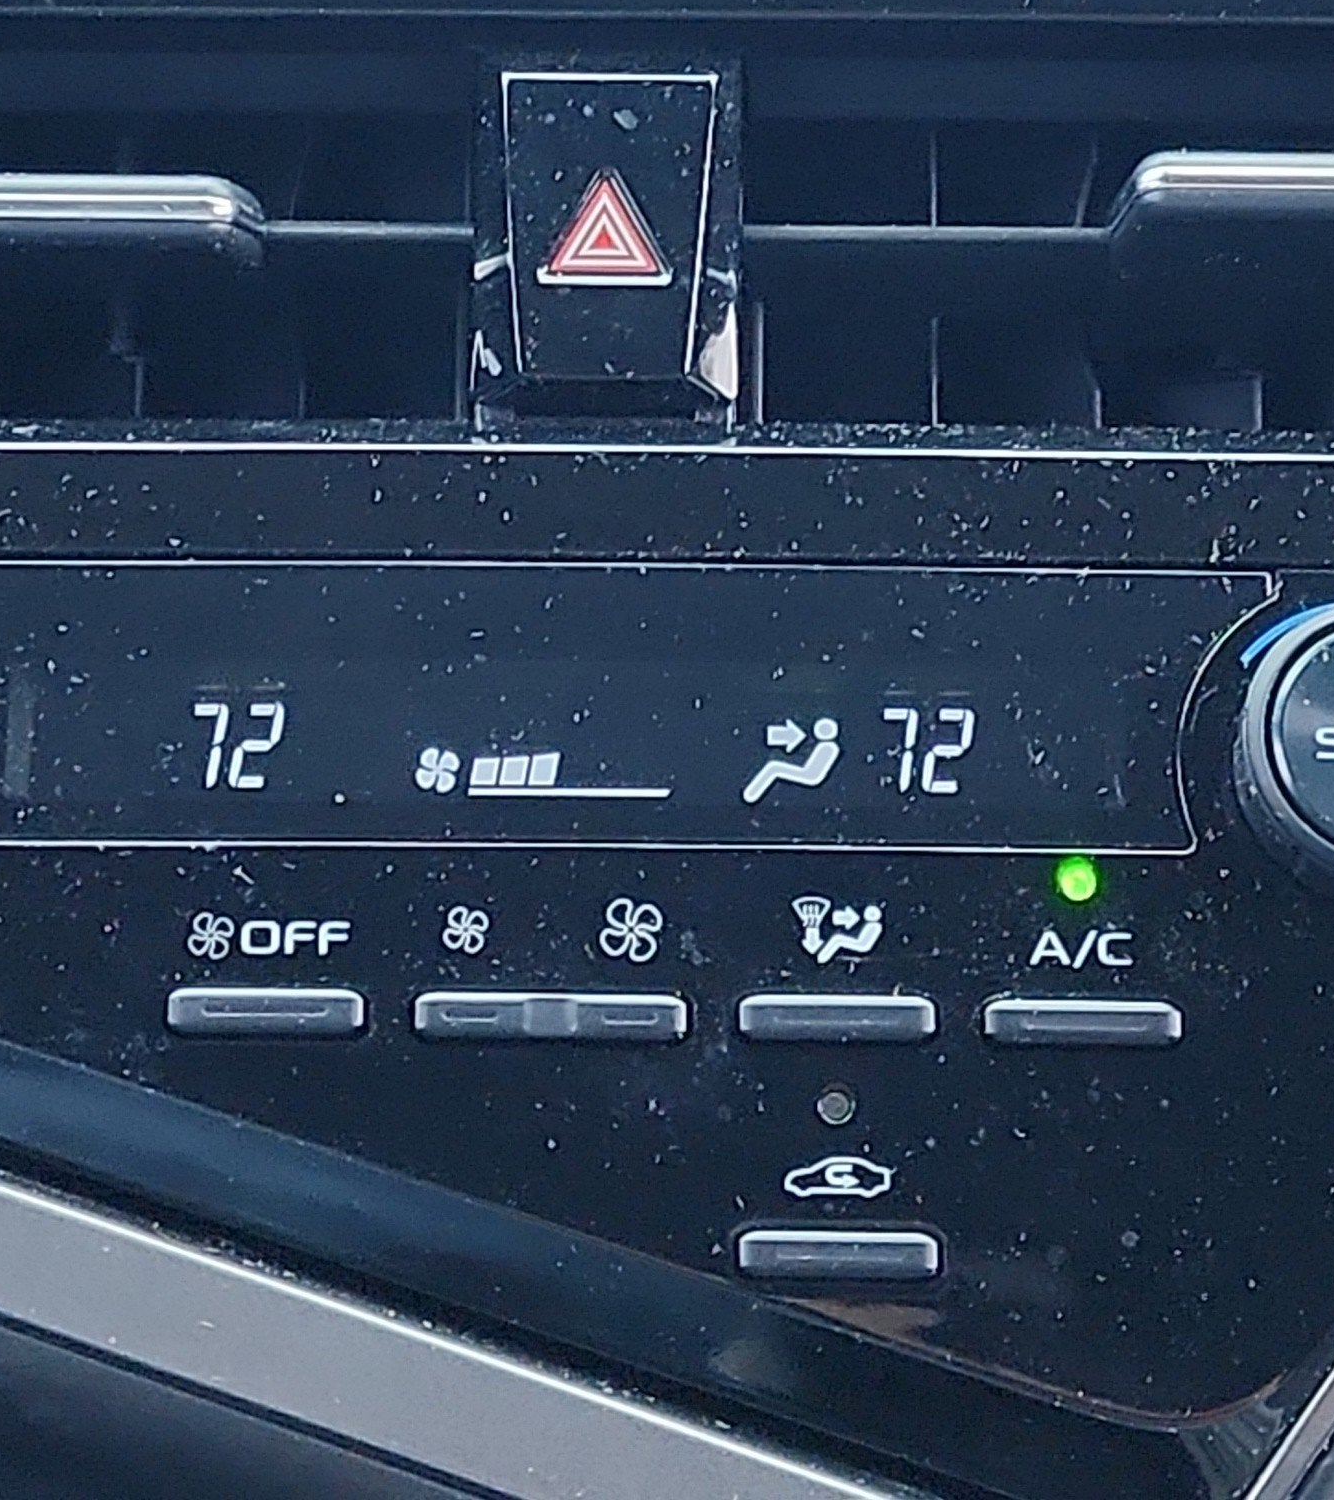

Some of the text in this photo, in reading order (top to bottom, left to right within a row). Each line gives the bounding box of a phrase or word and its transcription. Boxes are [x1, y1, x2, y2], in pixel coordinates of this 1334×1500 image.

[193, 702, 285, 789] 72
[882, 707, 976, 794] 72
[239, 919, 352, 956] OFF
[1029, 929, 1134, 971] A/C
